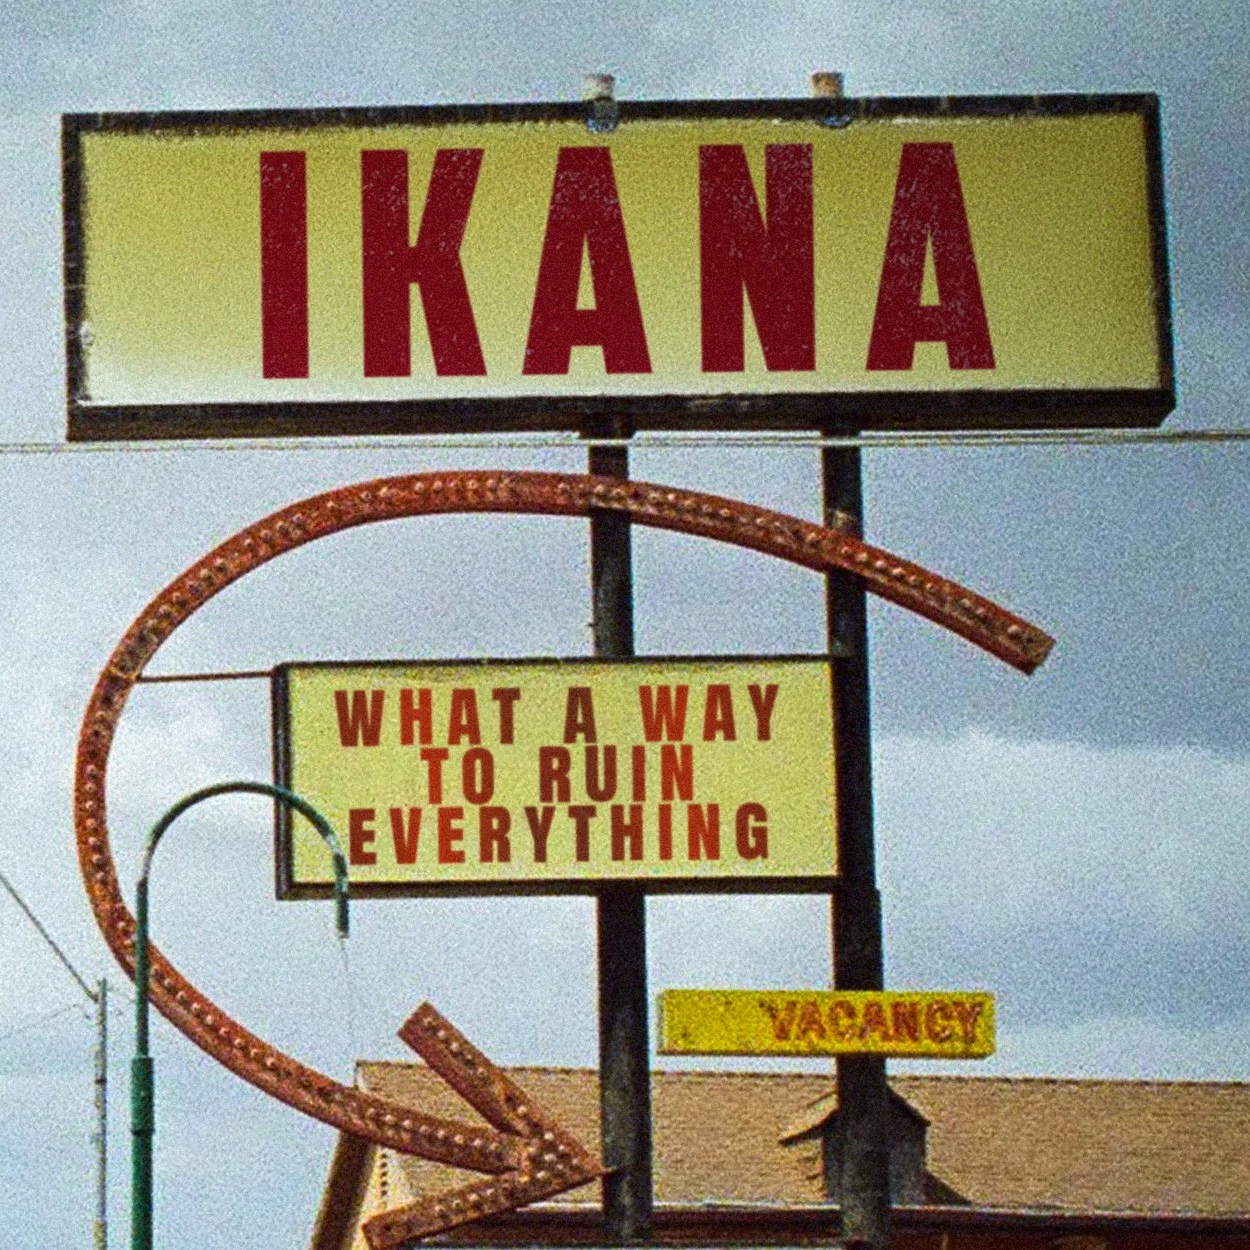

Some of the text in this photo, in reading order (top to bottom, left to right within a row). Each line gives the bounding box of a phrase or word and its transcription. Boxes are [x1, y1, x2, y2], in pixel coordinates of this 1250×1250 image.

[258, 140, 997, 379] IKANA
[334, 683, 780, 747] WHAT A WAY
[419, 743, 695, 805] TO RUIN
[348, 802, 770, 866] EVERYTHING
[762, 999, 984, 1045] VACANCY
